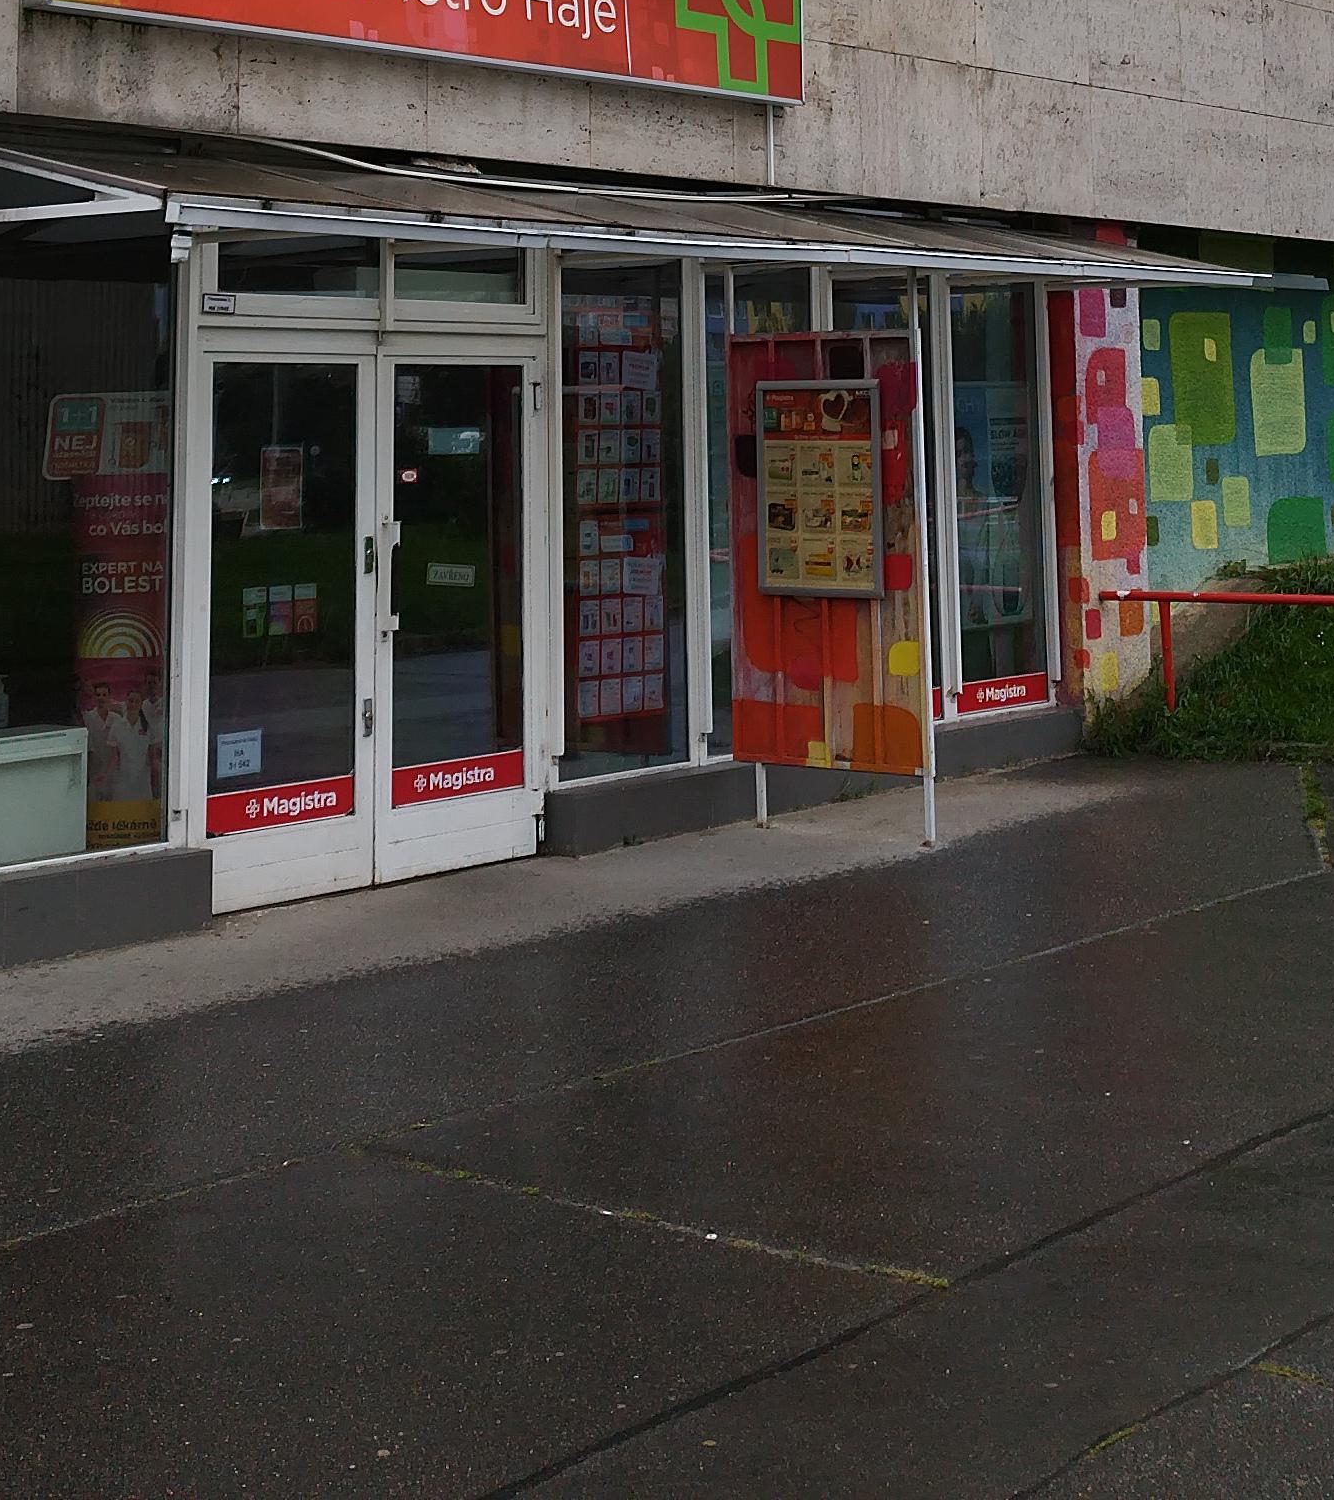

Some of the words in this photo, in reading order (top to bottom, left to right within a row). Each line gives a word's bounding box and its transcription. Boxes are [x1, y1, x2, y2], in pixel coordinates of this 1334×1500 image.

[54, 435, 98, 451] NEJ
[133, 494, 153, 507] se
[89, 524, 107, 536] co
[110, 521, 139, 536] Vás
[82, 562, 137, 575] EXPERT
[142, 560, 164, 573] NA
[82, 575, 164, 594] BOLEST
[985, 684, 1027, 703] Magistra
[429, 766, 495, 791] Magistra
[263, 791, 337, 817] Magistra
